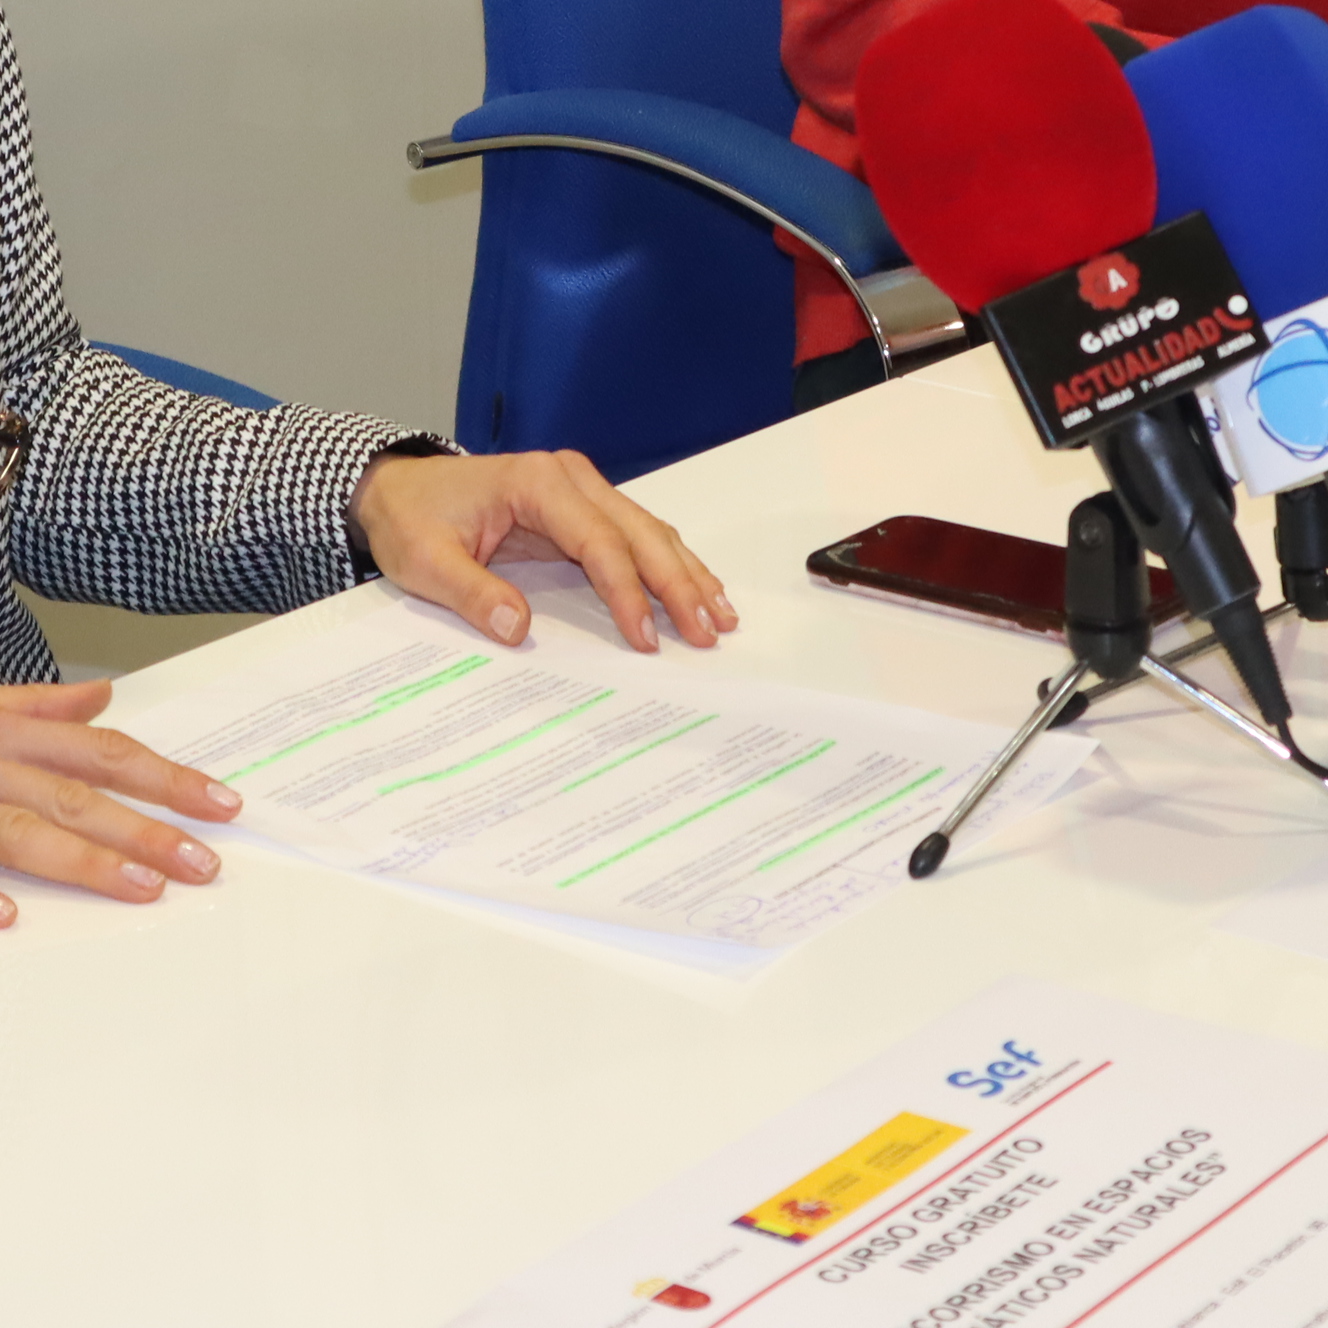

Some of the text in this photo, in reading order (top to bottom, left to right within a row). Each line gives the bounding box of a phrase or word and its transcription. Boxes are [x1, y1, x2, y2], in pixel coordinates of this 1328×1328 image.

[1053, 317, 1222, 413] ACTUALIDAD
[1080, 296, 1180, 354] GRUPO
[946, 1040, 1041, 1098] Sef
[817, 1224, 918, 1284] CURSO
[911, 1138, 1043, 1223] GRATUITO
[901, 1174, 1057, 1273] INSCRÍBETE
[1044, 1213, 1095, 1241] EN
[1082, 1128, 1211, 1214] ESPACIOS
